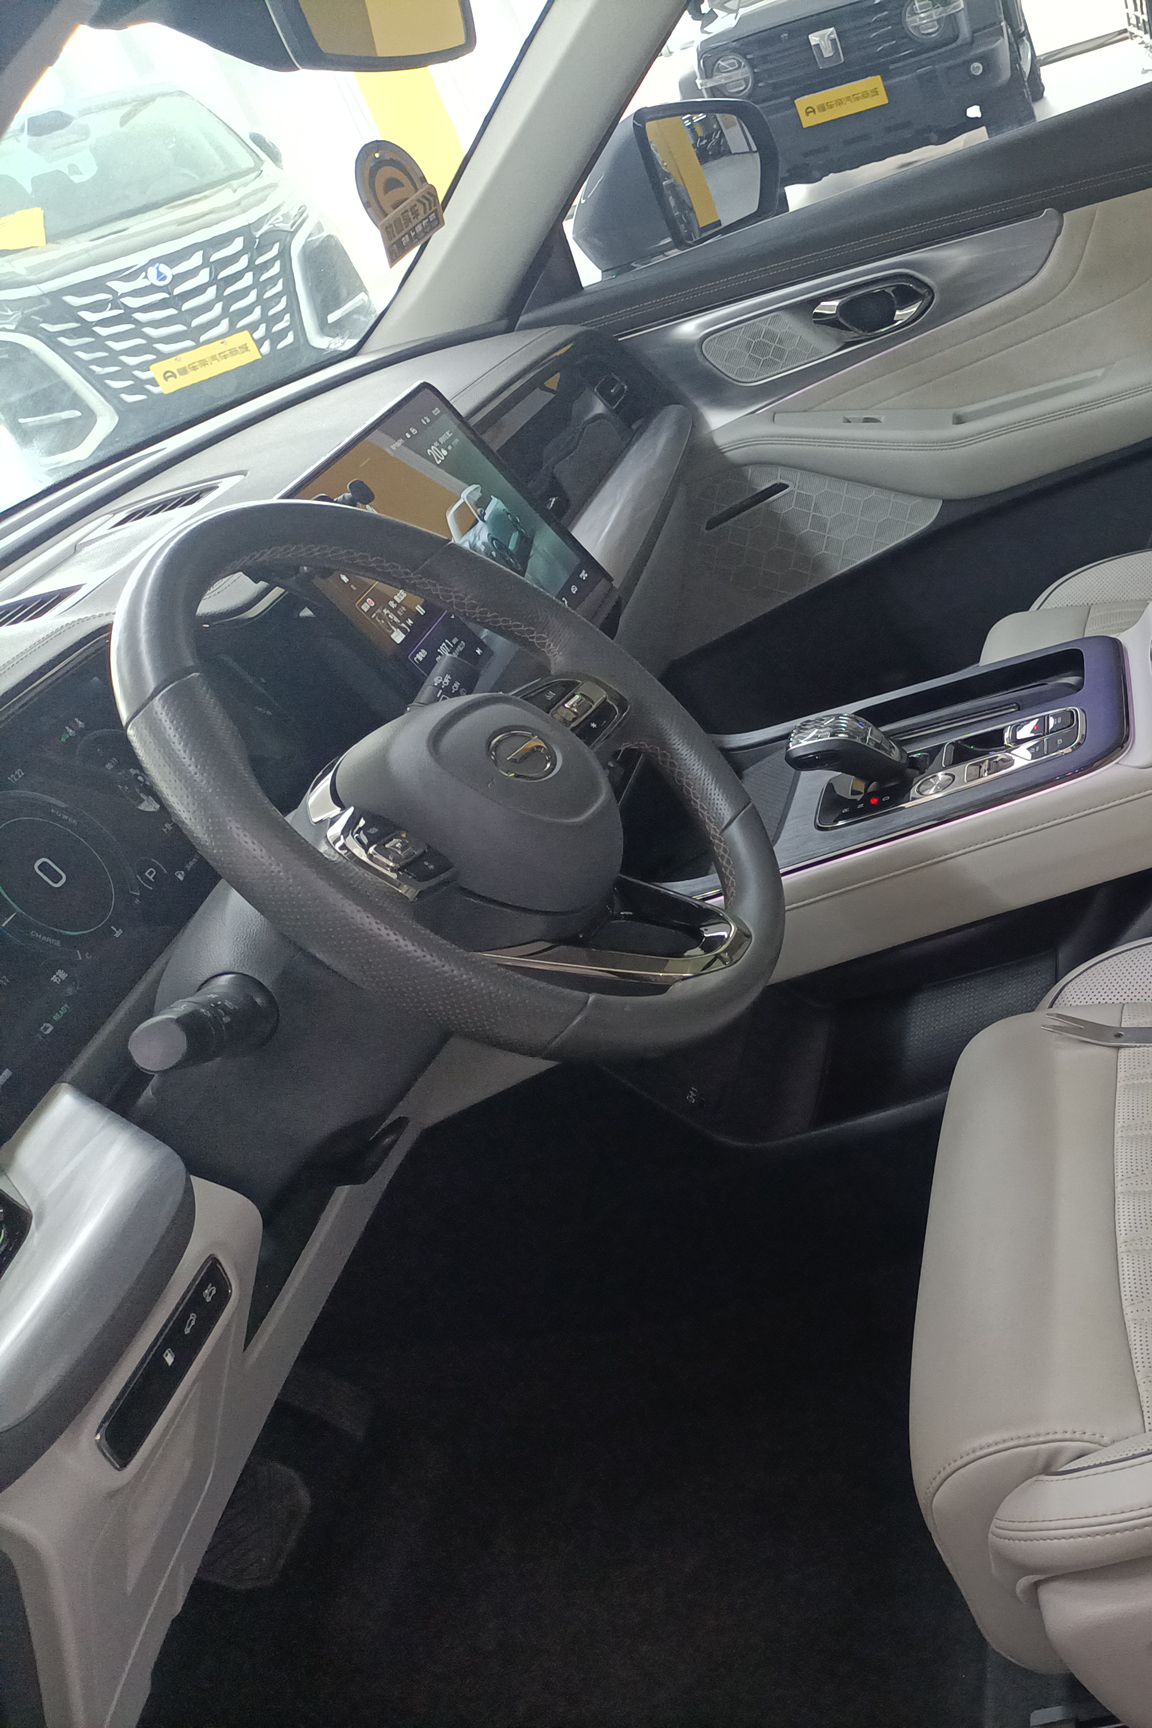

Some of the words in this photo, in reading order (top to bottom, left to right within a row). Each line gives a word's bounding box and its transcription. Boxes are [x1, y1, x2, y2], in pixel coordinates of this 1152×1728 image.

[33, 857, 67, 888] 0
[145, 866, 158, 883] P
[30, 929, 62, 947] CHARGE
[51, 1002, 71, 1022] READY
